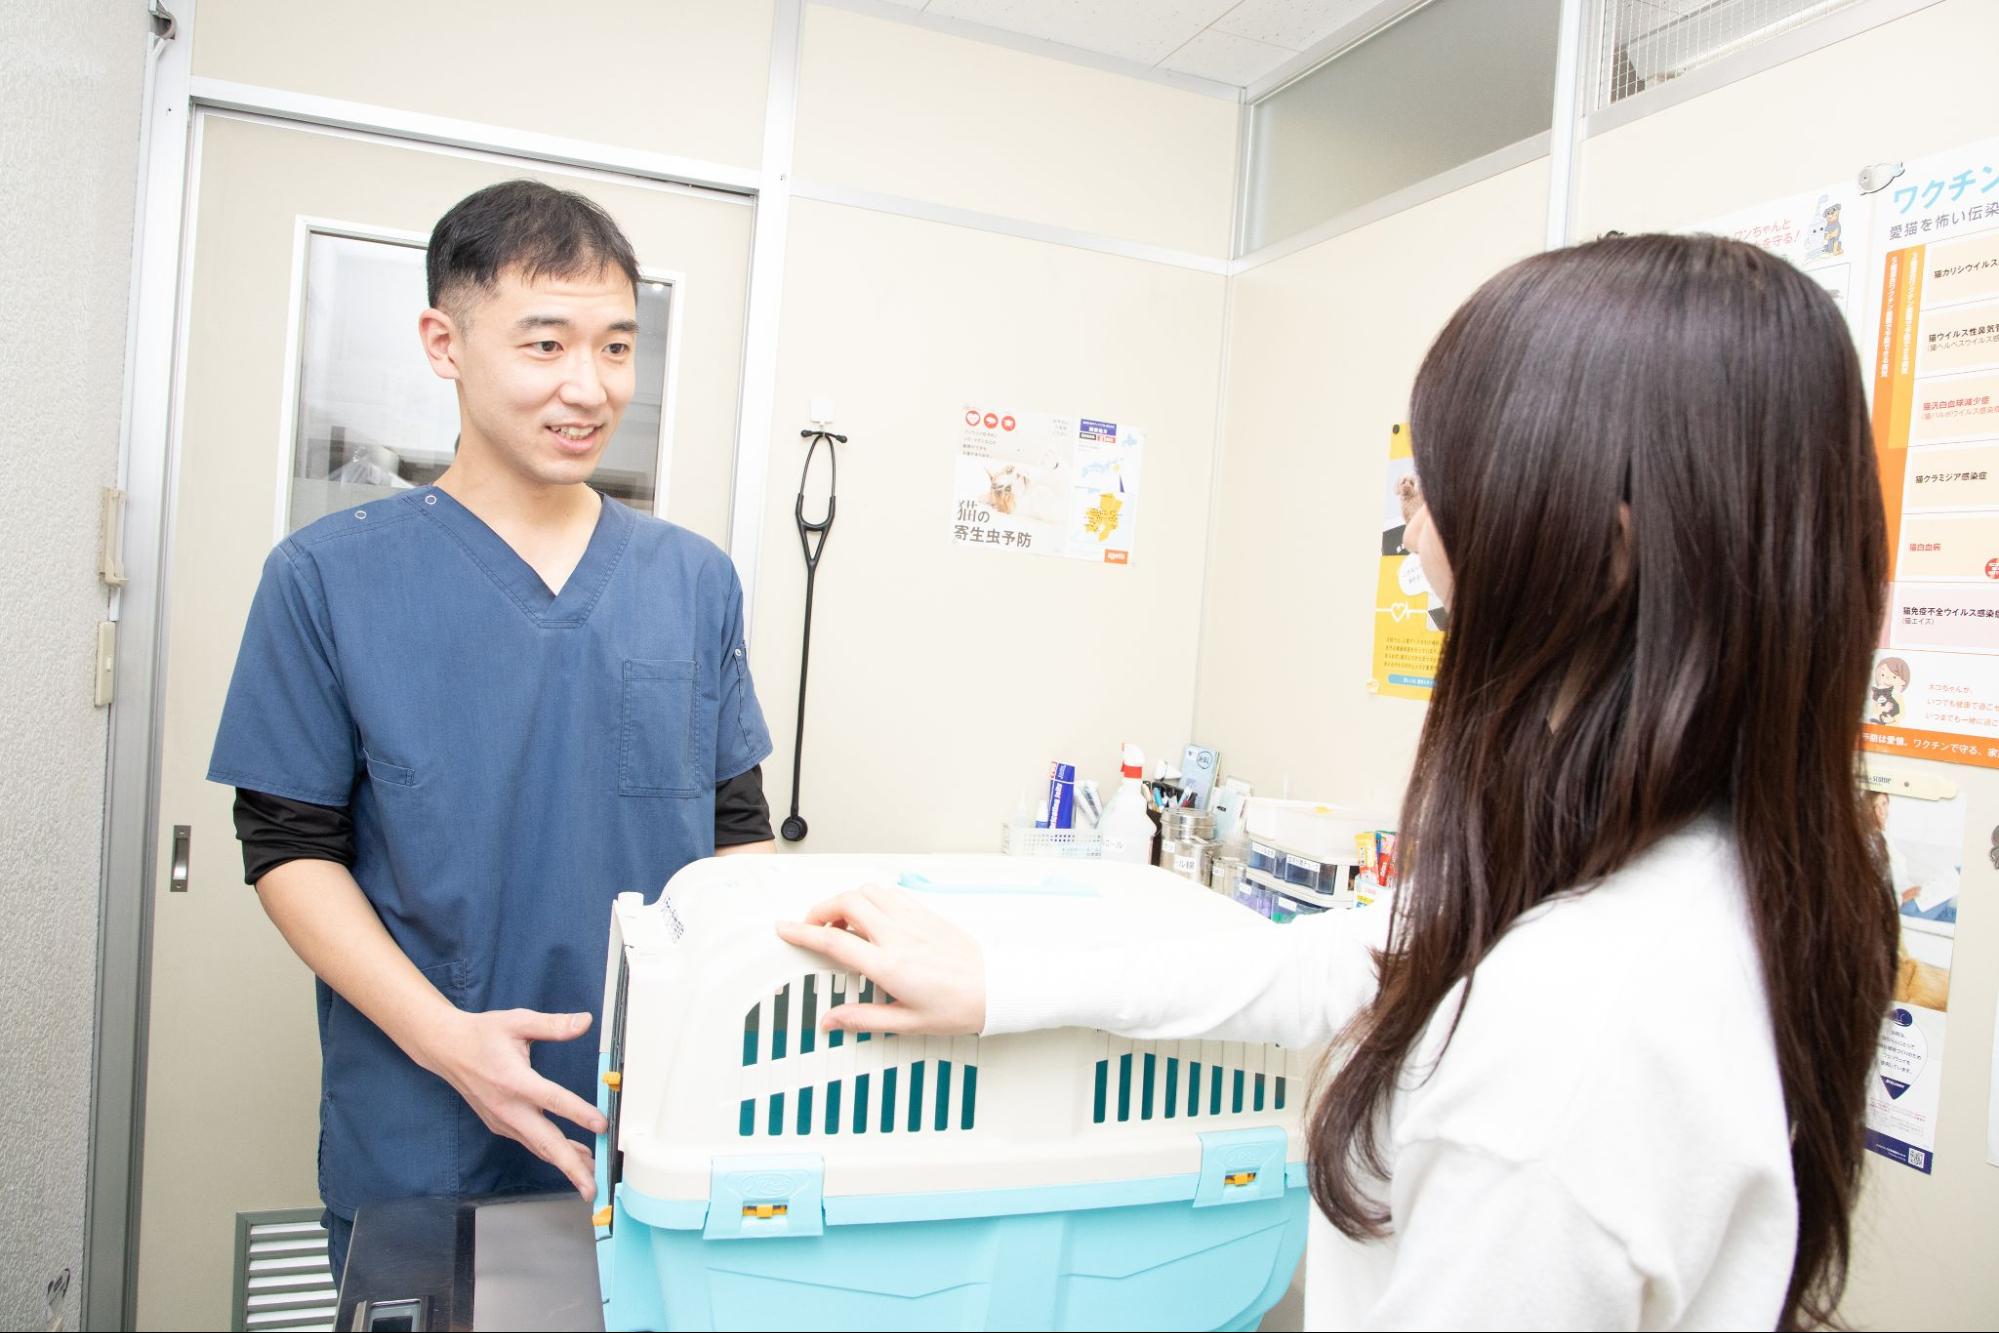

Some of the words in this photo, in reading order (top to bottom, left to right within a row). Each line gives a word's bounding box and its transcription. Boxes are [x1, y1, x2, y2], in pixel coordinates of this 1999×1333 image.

[1893, 165, 1999, 215] ワクチン
[1933, 257, 1999, 279] 猫カリシウイルス
[953, 524, 1032, 549] 寄生虫予防
